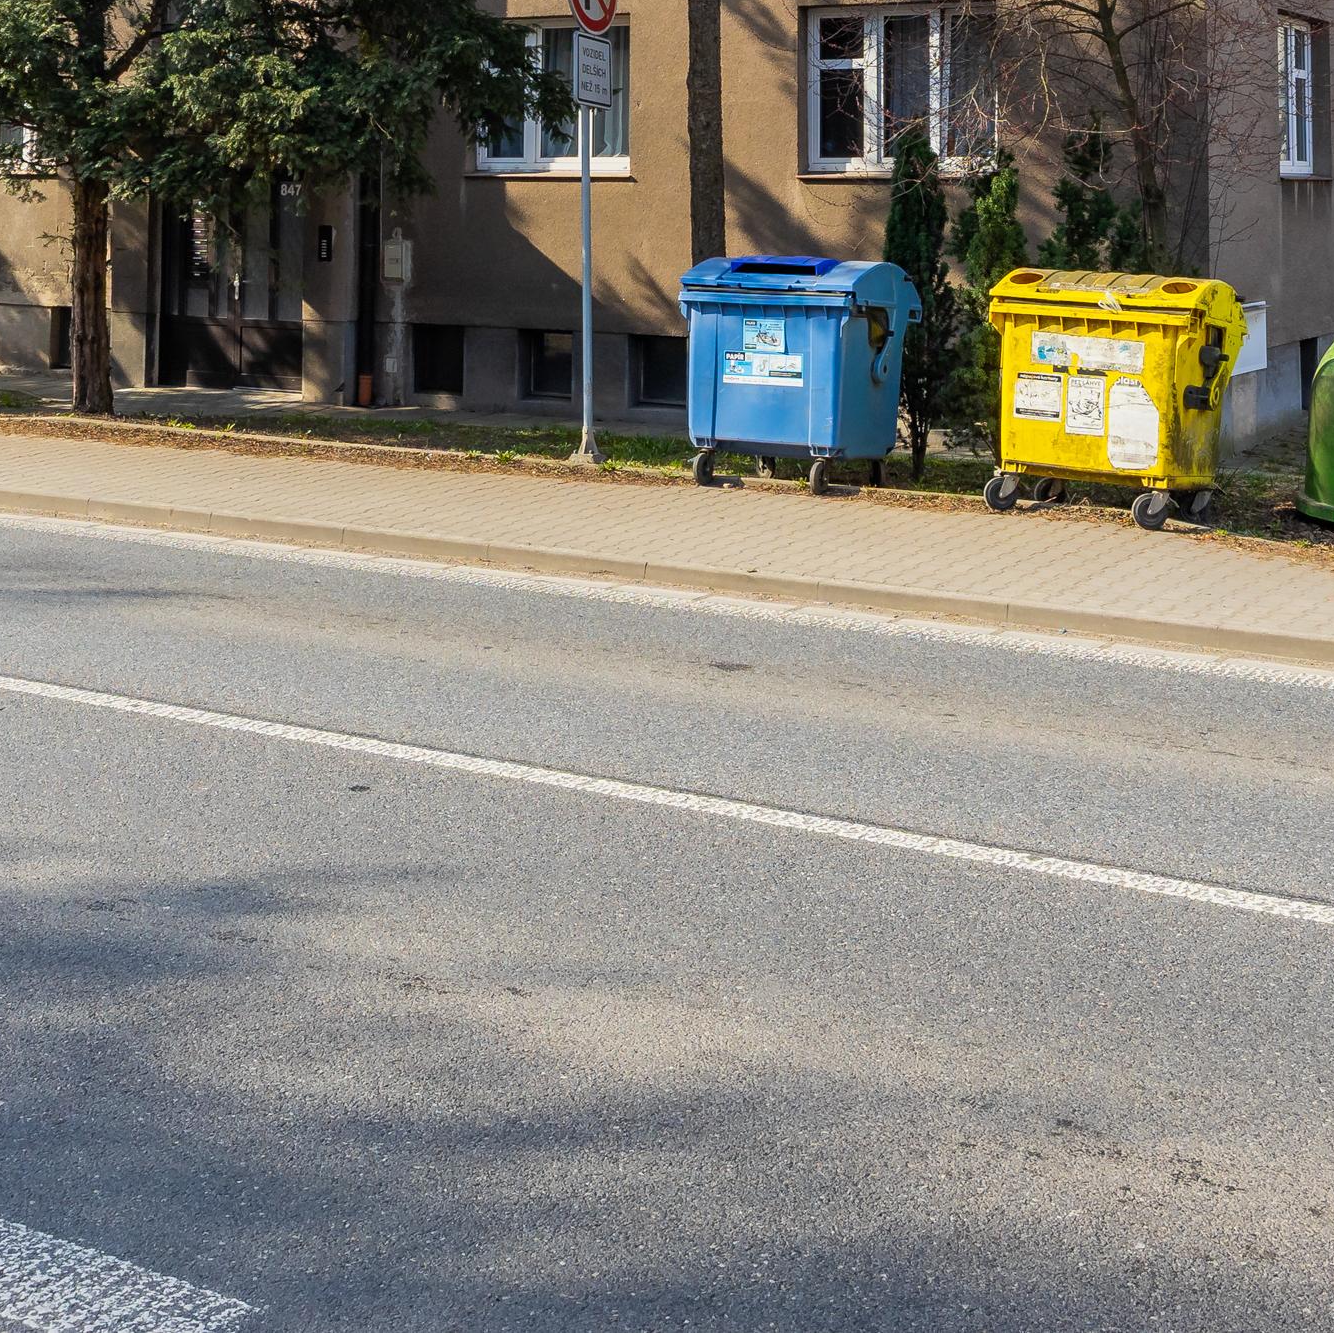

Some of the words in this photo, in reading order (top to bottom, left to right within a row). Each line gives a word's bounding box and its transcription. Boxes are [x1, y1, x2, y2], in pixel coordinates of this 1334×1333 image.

[582, 47, 607, 62] VOZIDEL
[582, 63, 607, 78] DELŠÍCH
[581, 80, 593, 92] NEŽ
[594, 84, 601, 94] 15
[280, 183, 302, 197] 847
[725, 352, 744, 361] PAPÍR
